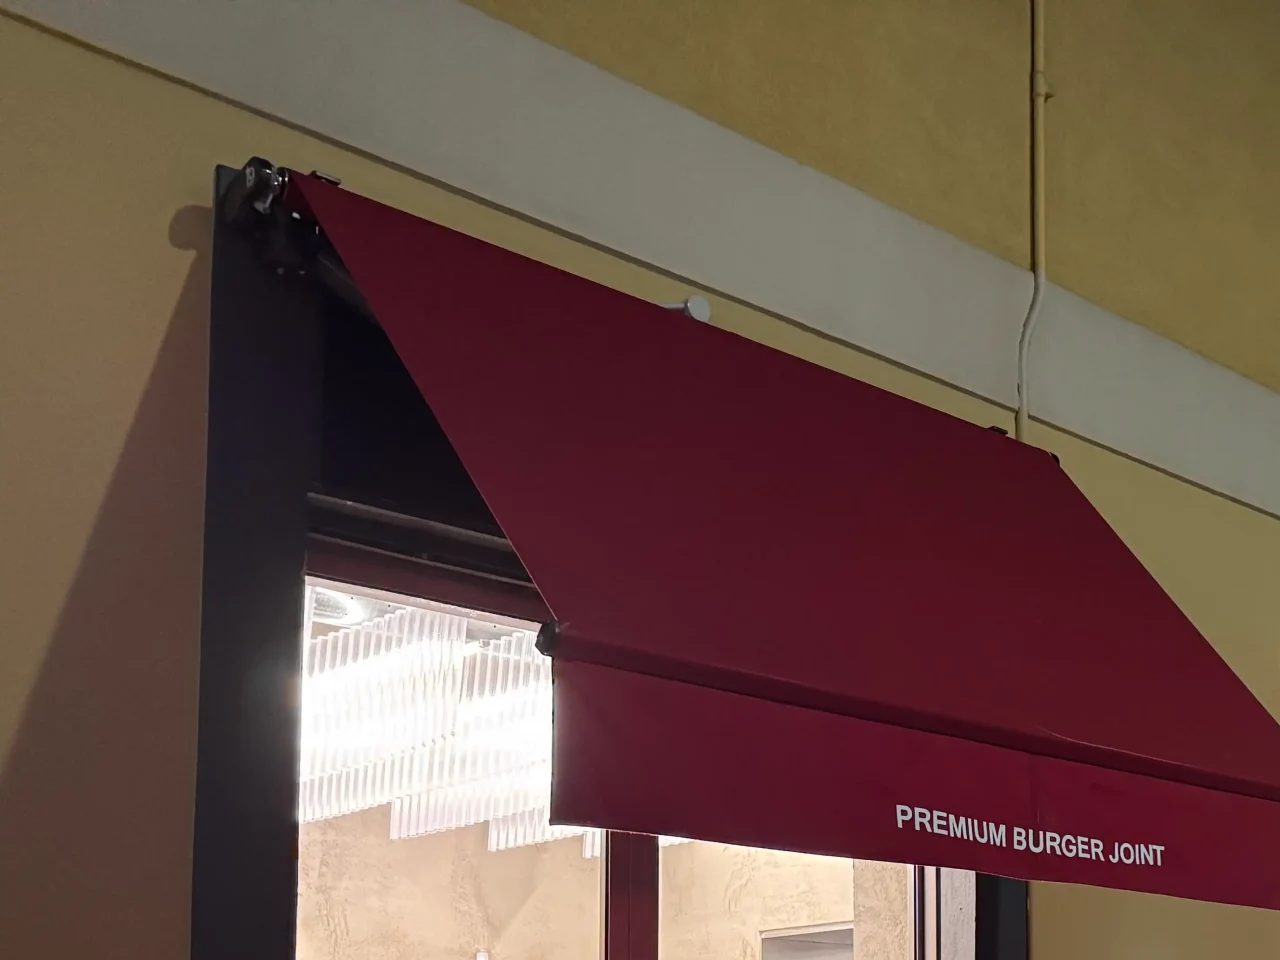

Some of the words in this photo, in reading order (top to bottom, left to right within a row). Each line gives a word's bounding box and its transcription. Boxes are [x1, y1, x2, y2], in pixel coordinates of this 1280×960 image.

[895, 804, 1006, 848] PREMIUM
[1013, 826, 1105, 862] BURGER
[1109, 842, 1165, 867] JOINT
